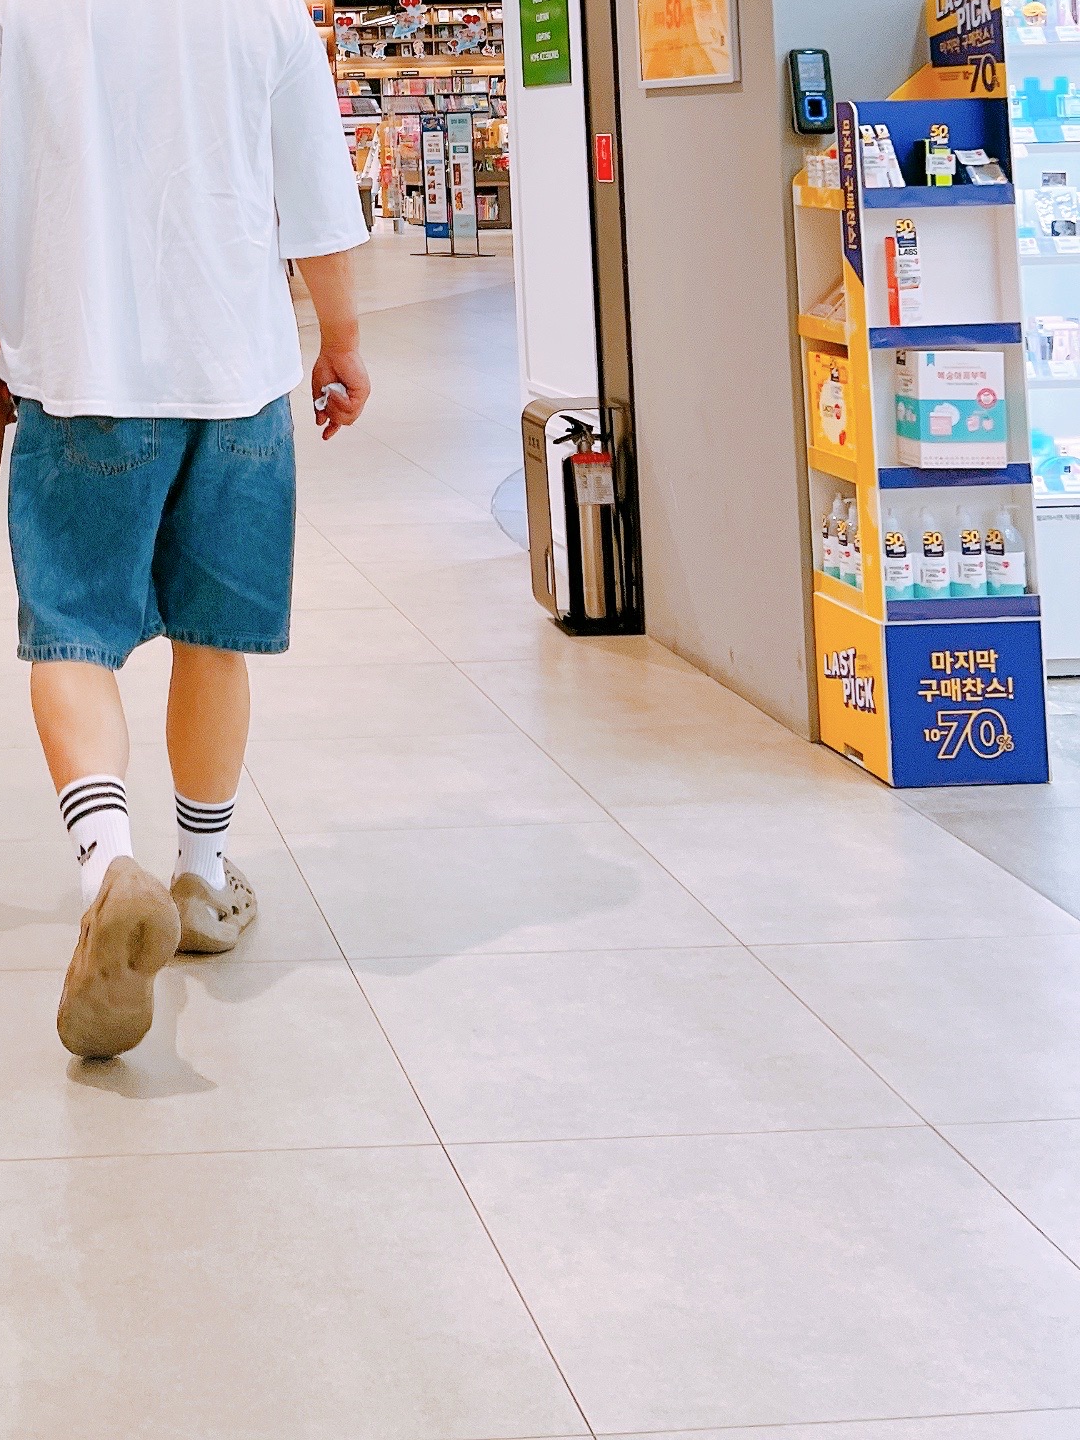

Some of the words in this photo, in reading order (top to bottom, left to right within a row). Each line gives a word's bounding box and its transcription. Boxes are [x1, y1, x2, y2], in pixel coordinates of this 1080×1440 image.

[823, 647, 857, 679] LAST
[931, 649, 998, 675] 마지막
[841, 676, 877, 714] PICK
[917, 676, 1015, 703] 구매찬스!
